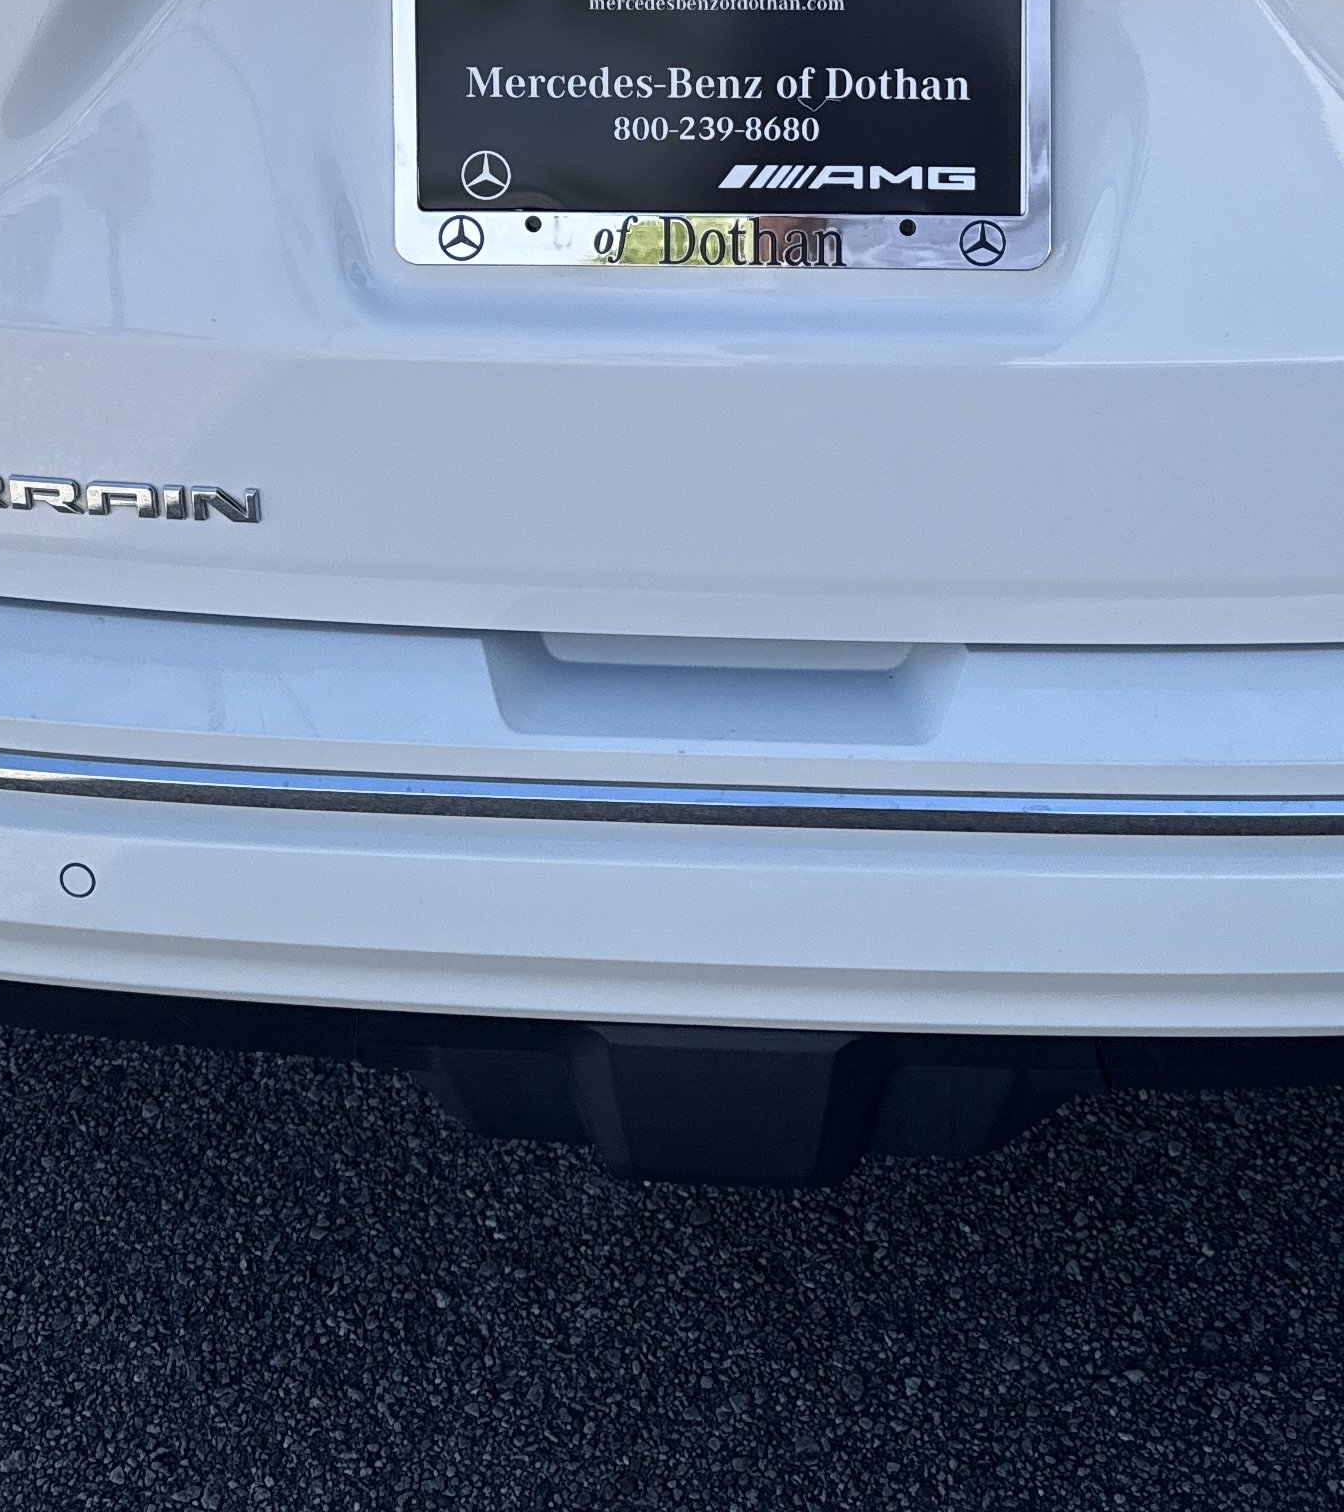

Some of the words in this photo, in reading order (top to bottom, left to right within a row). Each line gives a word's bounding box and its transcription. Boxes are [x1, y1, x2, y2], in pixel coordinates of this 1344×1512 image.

[465, 66, 763, 101] Mercedes-Benz
[775, 66, 815, 101] of
[825, 68, 971, 102] Dothan
[613, 115, 820, 142] 800-239-8680
[594, 216, 637, 264] of
[658, 216, 847, 267] Dothan
